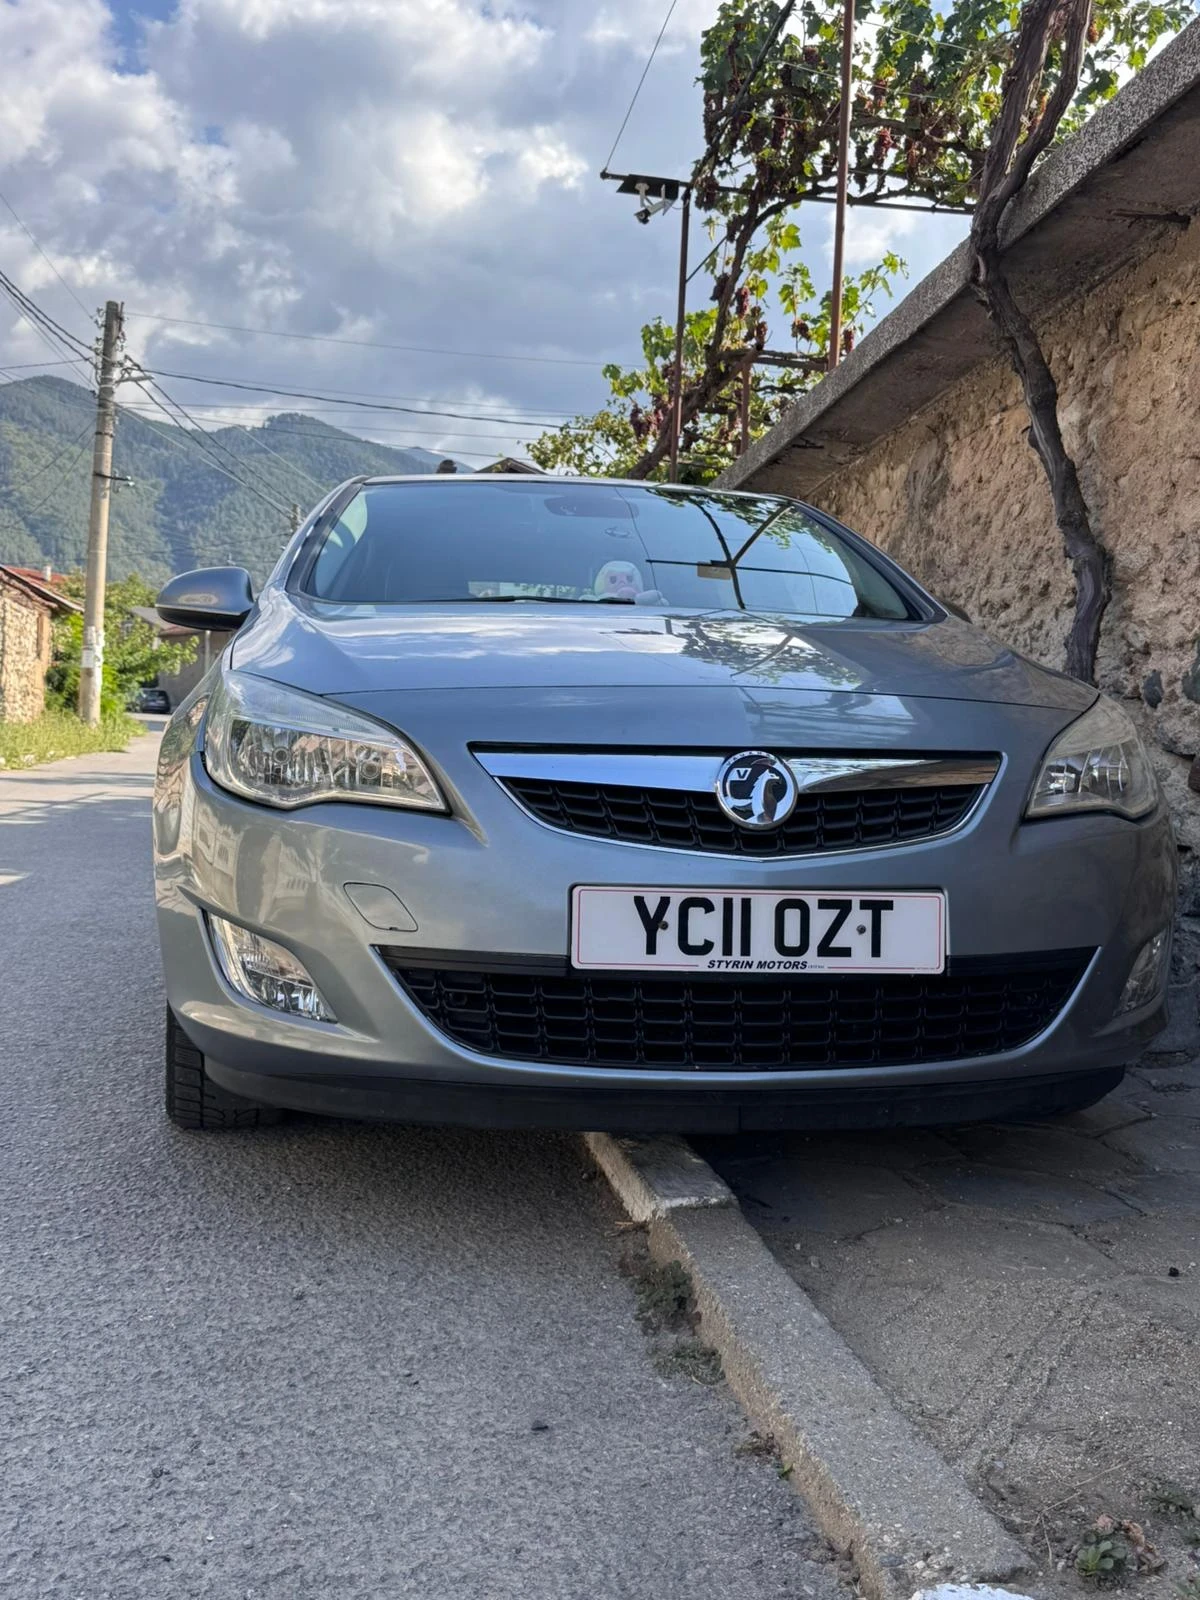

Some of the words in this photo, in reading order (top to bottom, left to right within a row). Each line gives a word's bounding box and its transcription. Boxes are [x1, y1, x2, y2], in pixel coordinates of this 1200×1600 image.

[736, 769, 749, 779] V
[634, 895, 751, 957] YC11
[774, 898, 893, 958] OZT
[707, 960, 753, 969] STYRIN
[756, 961, 808, 970] MOTORS
